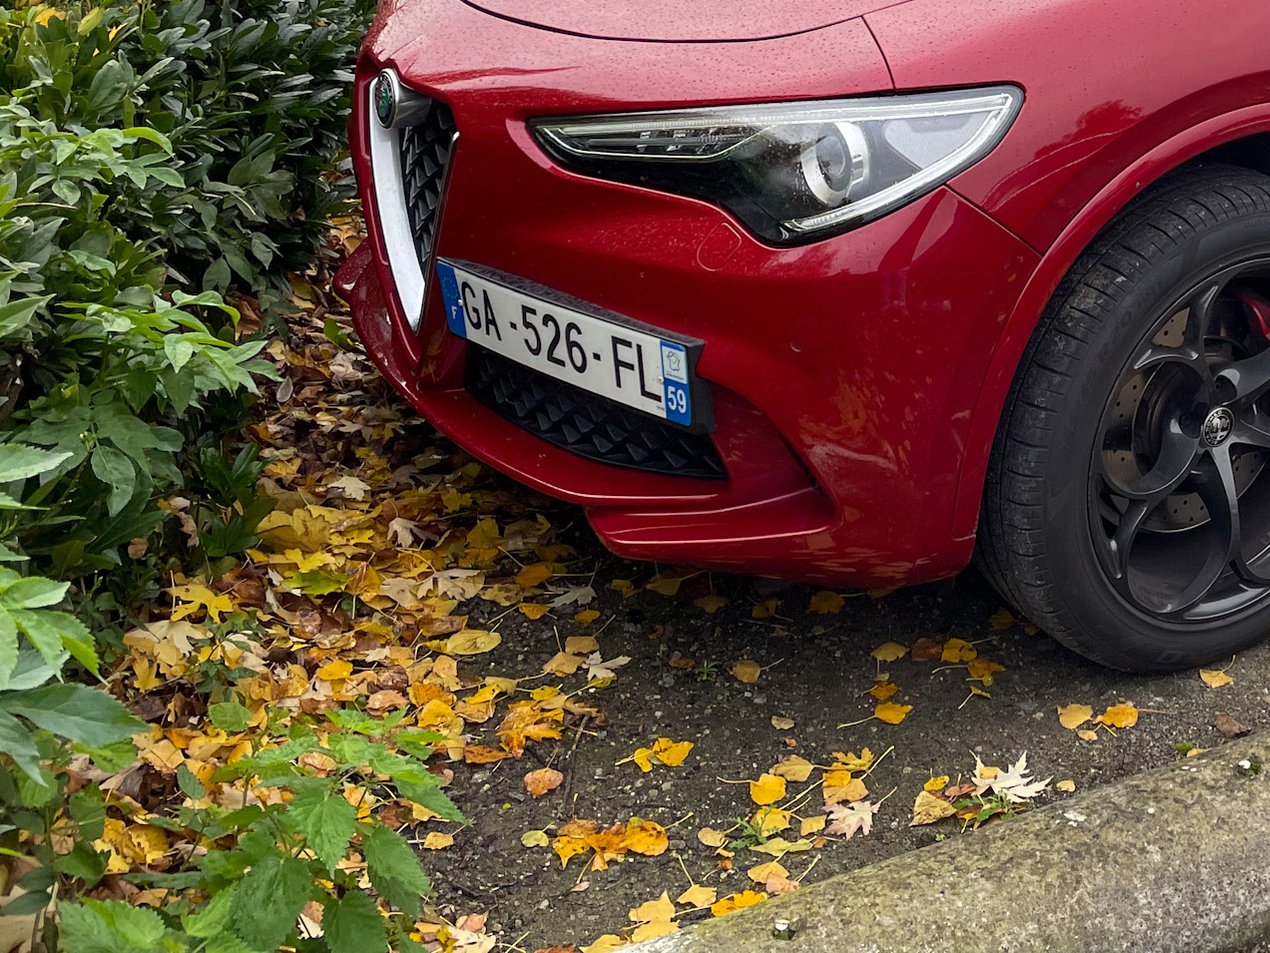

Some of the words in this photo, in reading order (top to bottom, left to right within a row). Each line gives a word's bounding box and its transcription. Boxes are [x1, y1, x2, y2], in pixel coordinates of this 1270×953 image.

[451, 306, 458, 319] F
[461, 281, 662, 402] GA-526-FL
[667, 385, 687, 414] 59
